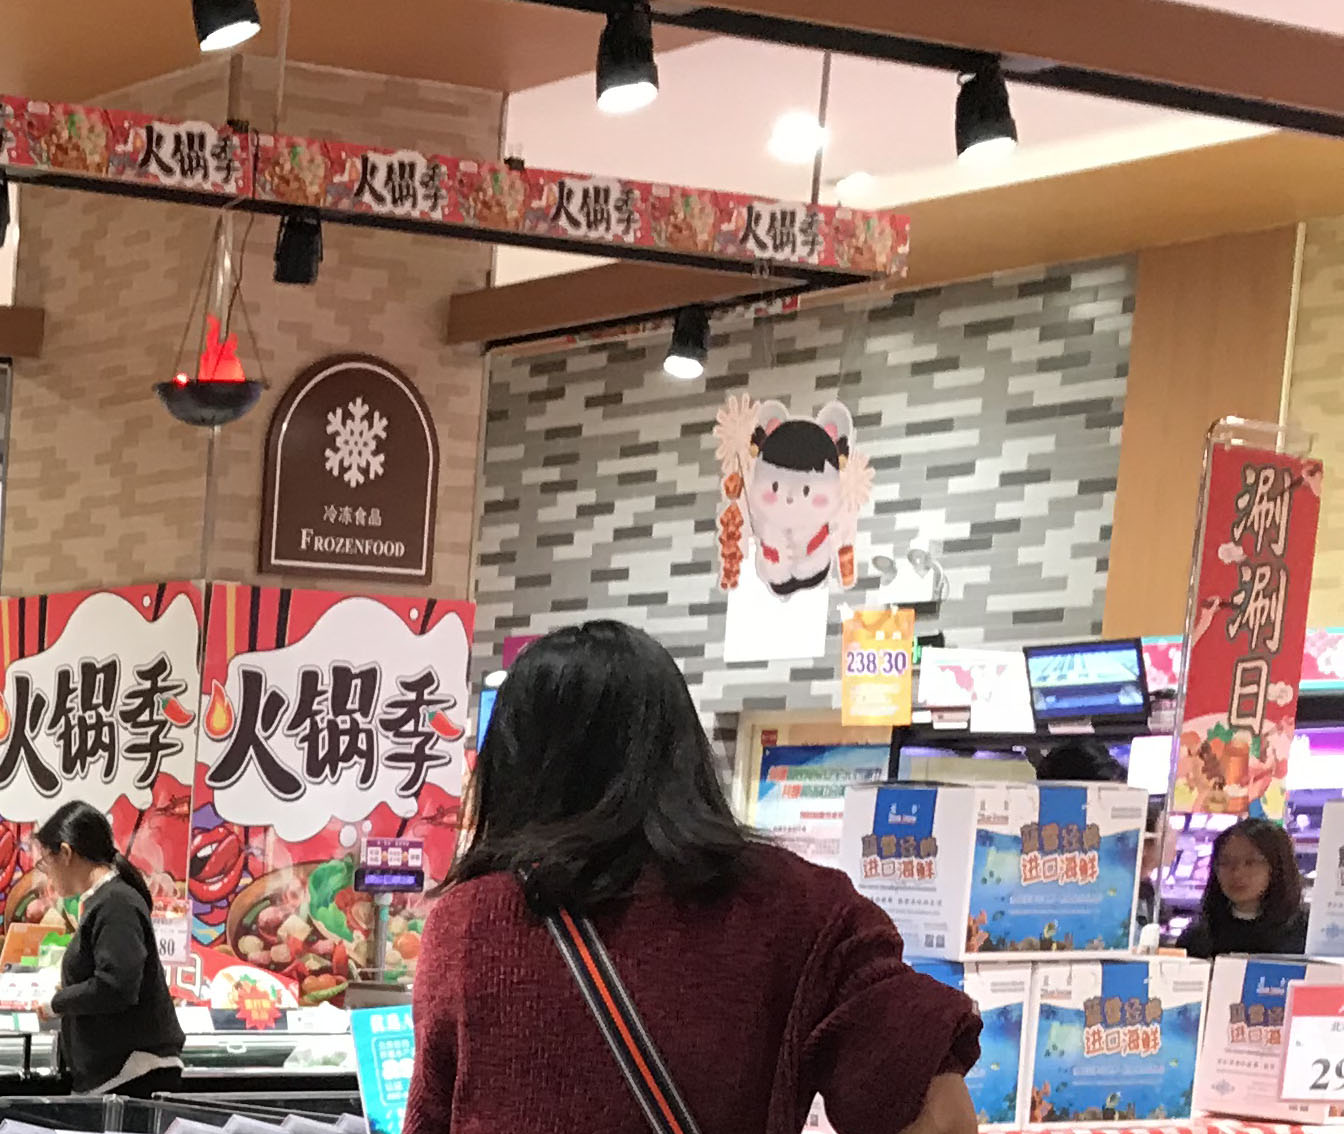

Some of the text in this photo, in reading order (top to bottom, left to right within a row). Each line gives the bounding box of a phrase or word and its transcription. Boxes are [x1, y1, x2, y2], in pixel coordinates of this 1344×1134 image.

[139, 124, 239, 184] 火锅季
[355, 155, 446, 212] 火锅季
[551, 179, 639, 234] 火锅季
[740, 202, 823, 256] 火锅季
[323, 504, 382, 527] 冷冻食品
[300, 528, 405, 557] FROZENFOOD
[1226, 464, 1292, 736] 涮涮日
[847, 651, 906, 674] 238 30
[209, 661, 453, 795] 火锅季
[862, 857, 935, 880] 进口海鲜
[1021, 854, 1099, 885] 进口海鲜
[1085, 1026, 1160, 1055] 进口海鲜
